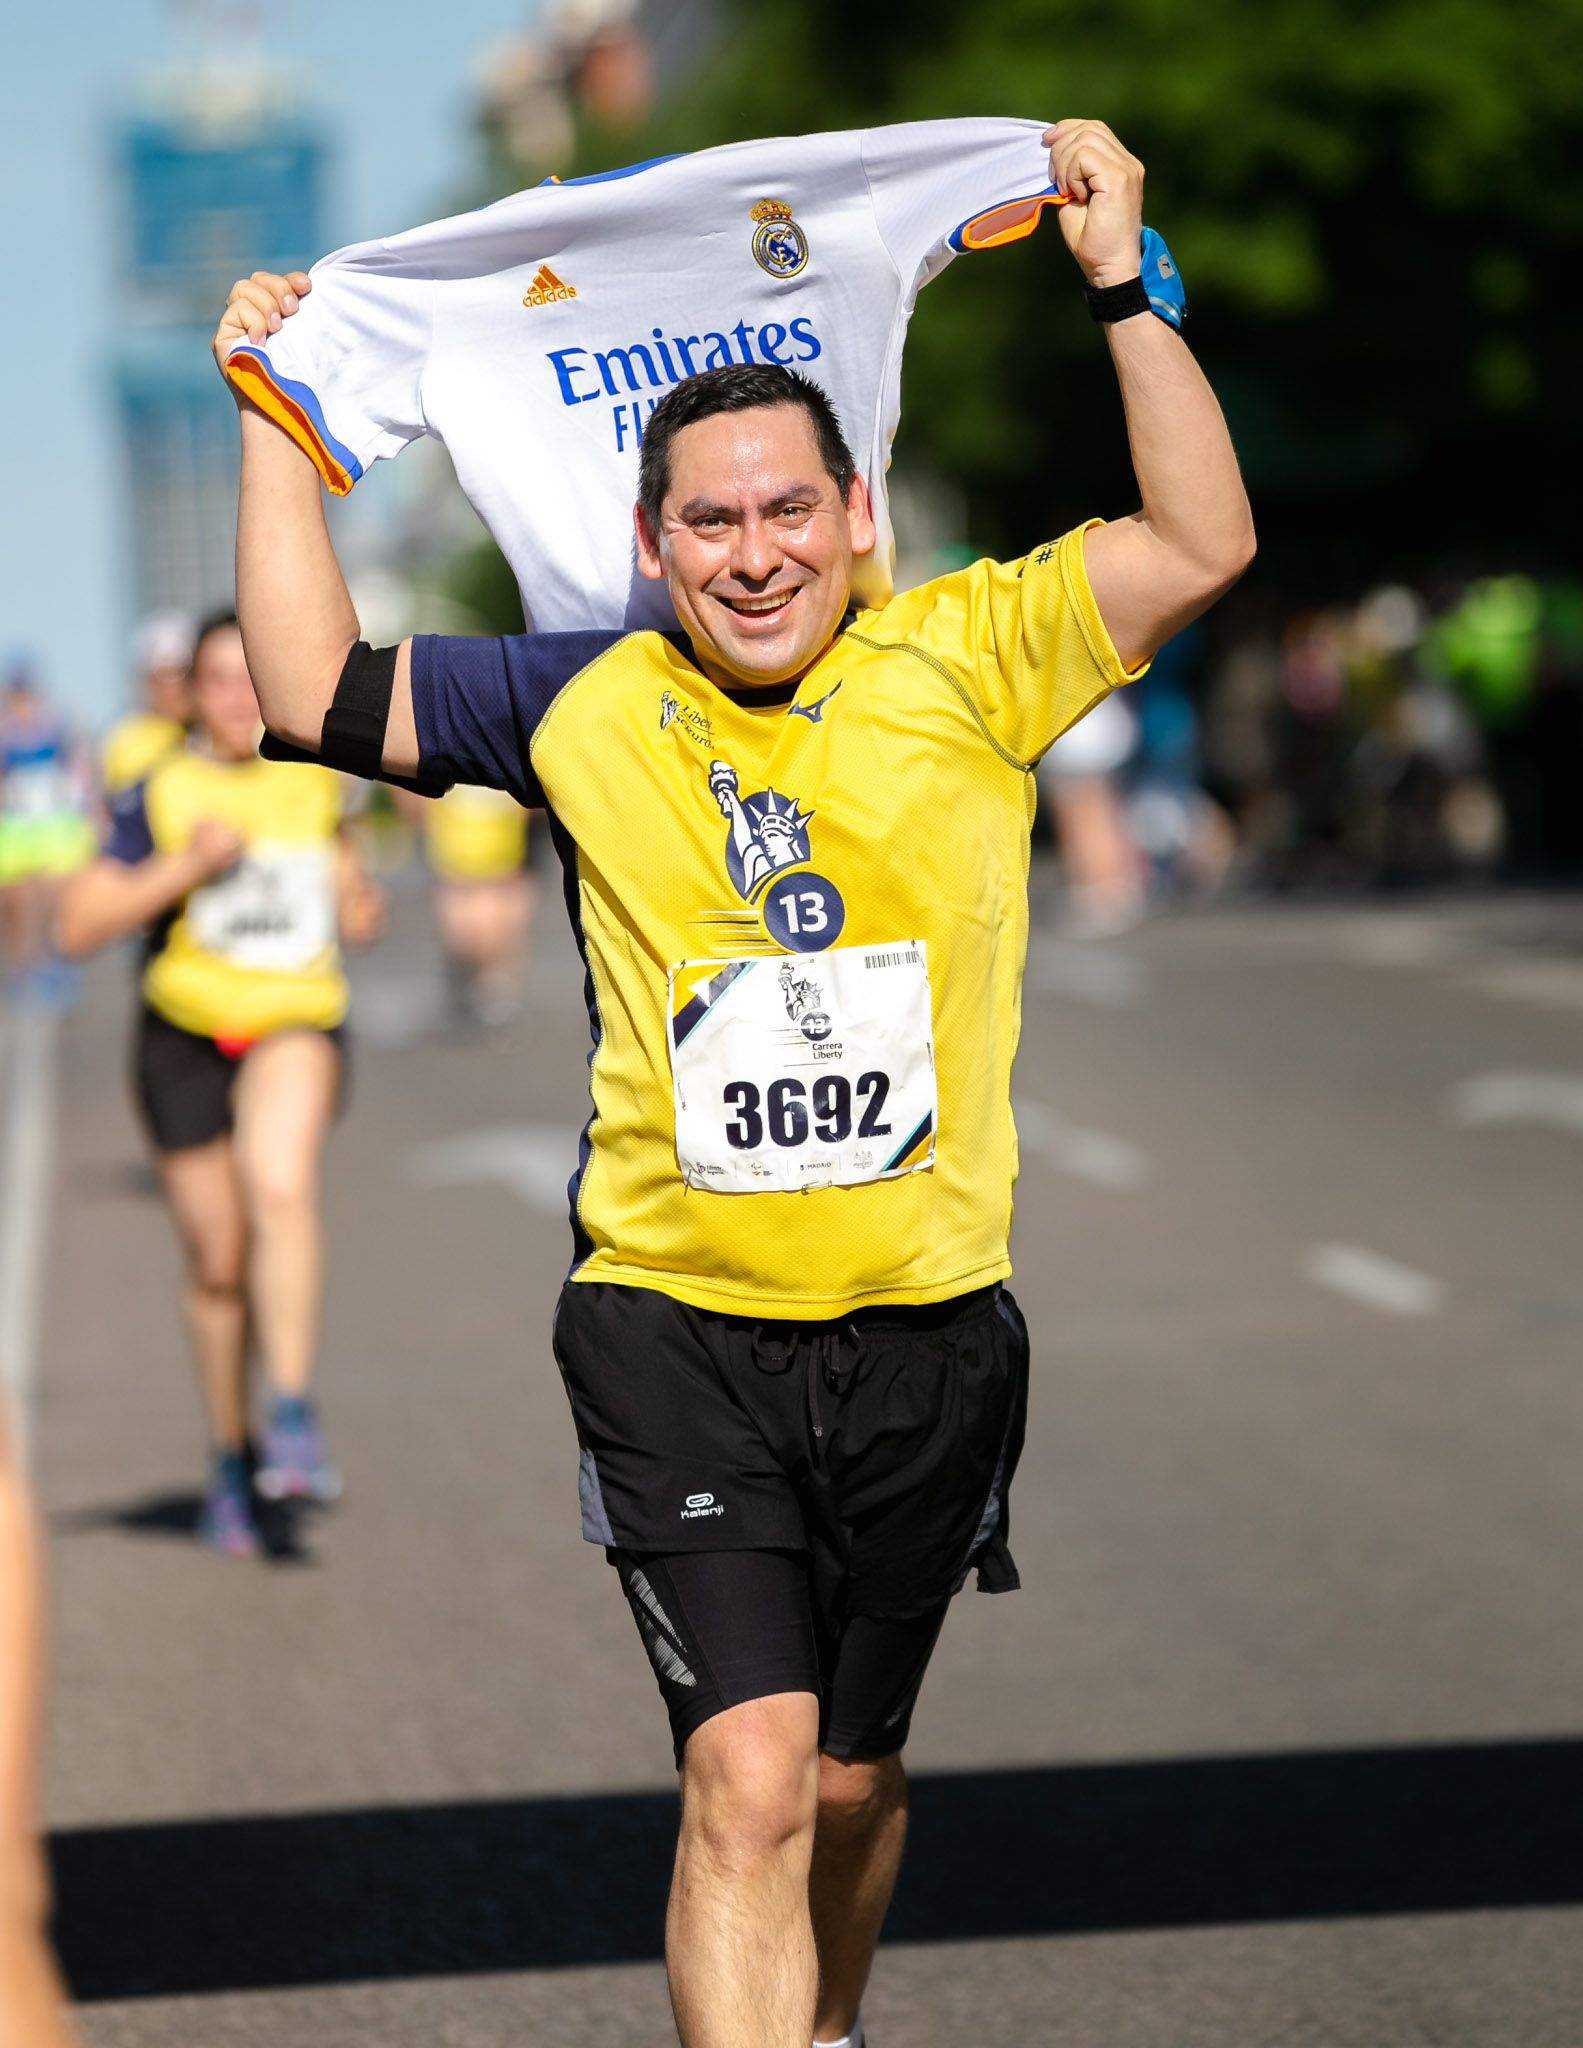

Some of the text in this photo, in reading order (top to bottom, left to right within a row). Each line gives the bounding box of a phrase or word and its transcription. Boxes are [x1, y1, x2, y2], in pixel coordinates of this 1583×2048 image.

[522, 286, 577, 307] adidas
[546, 317, 821, 406] Emirates
[779, 892, 828, 934] 13
[805, 1018, 828, 1035] 13
[812, 1042, 843, 1051] Carrera
[813, 1050, 843, 1060] Liberty
[723, 1070, 892, 1150] 3692
[807, 1162, 832, 1170] MADRID
[680, 1505, 724, 1519] Kalenji
